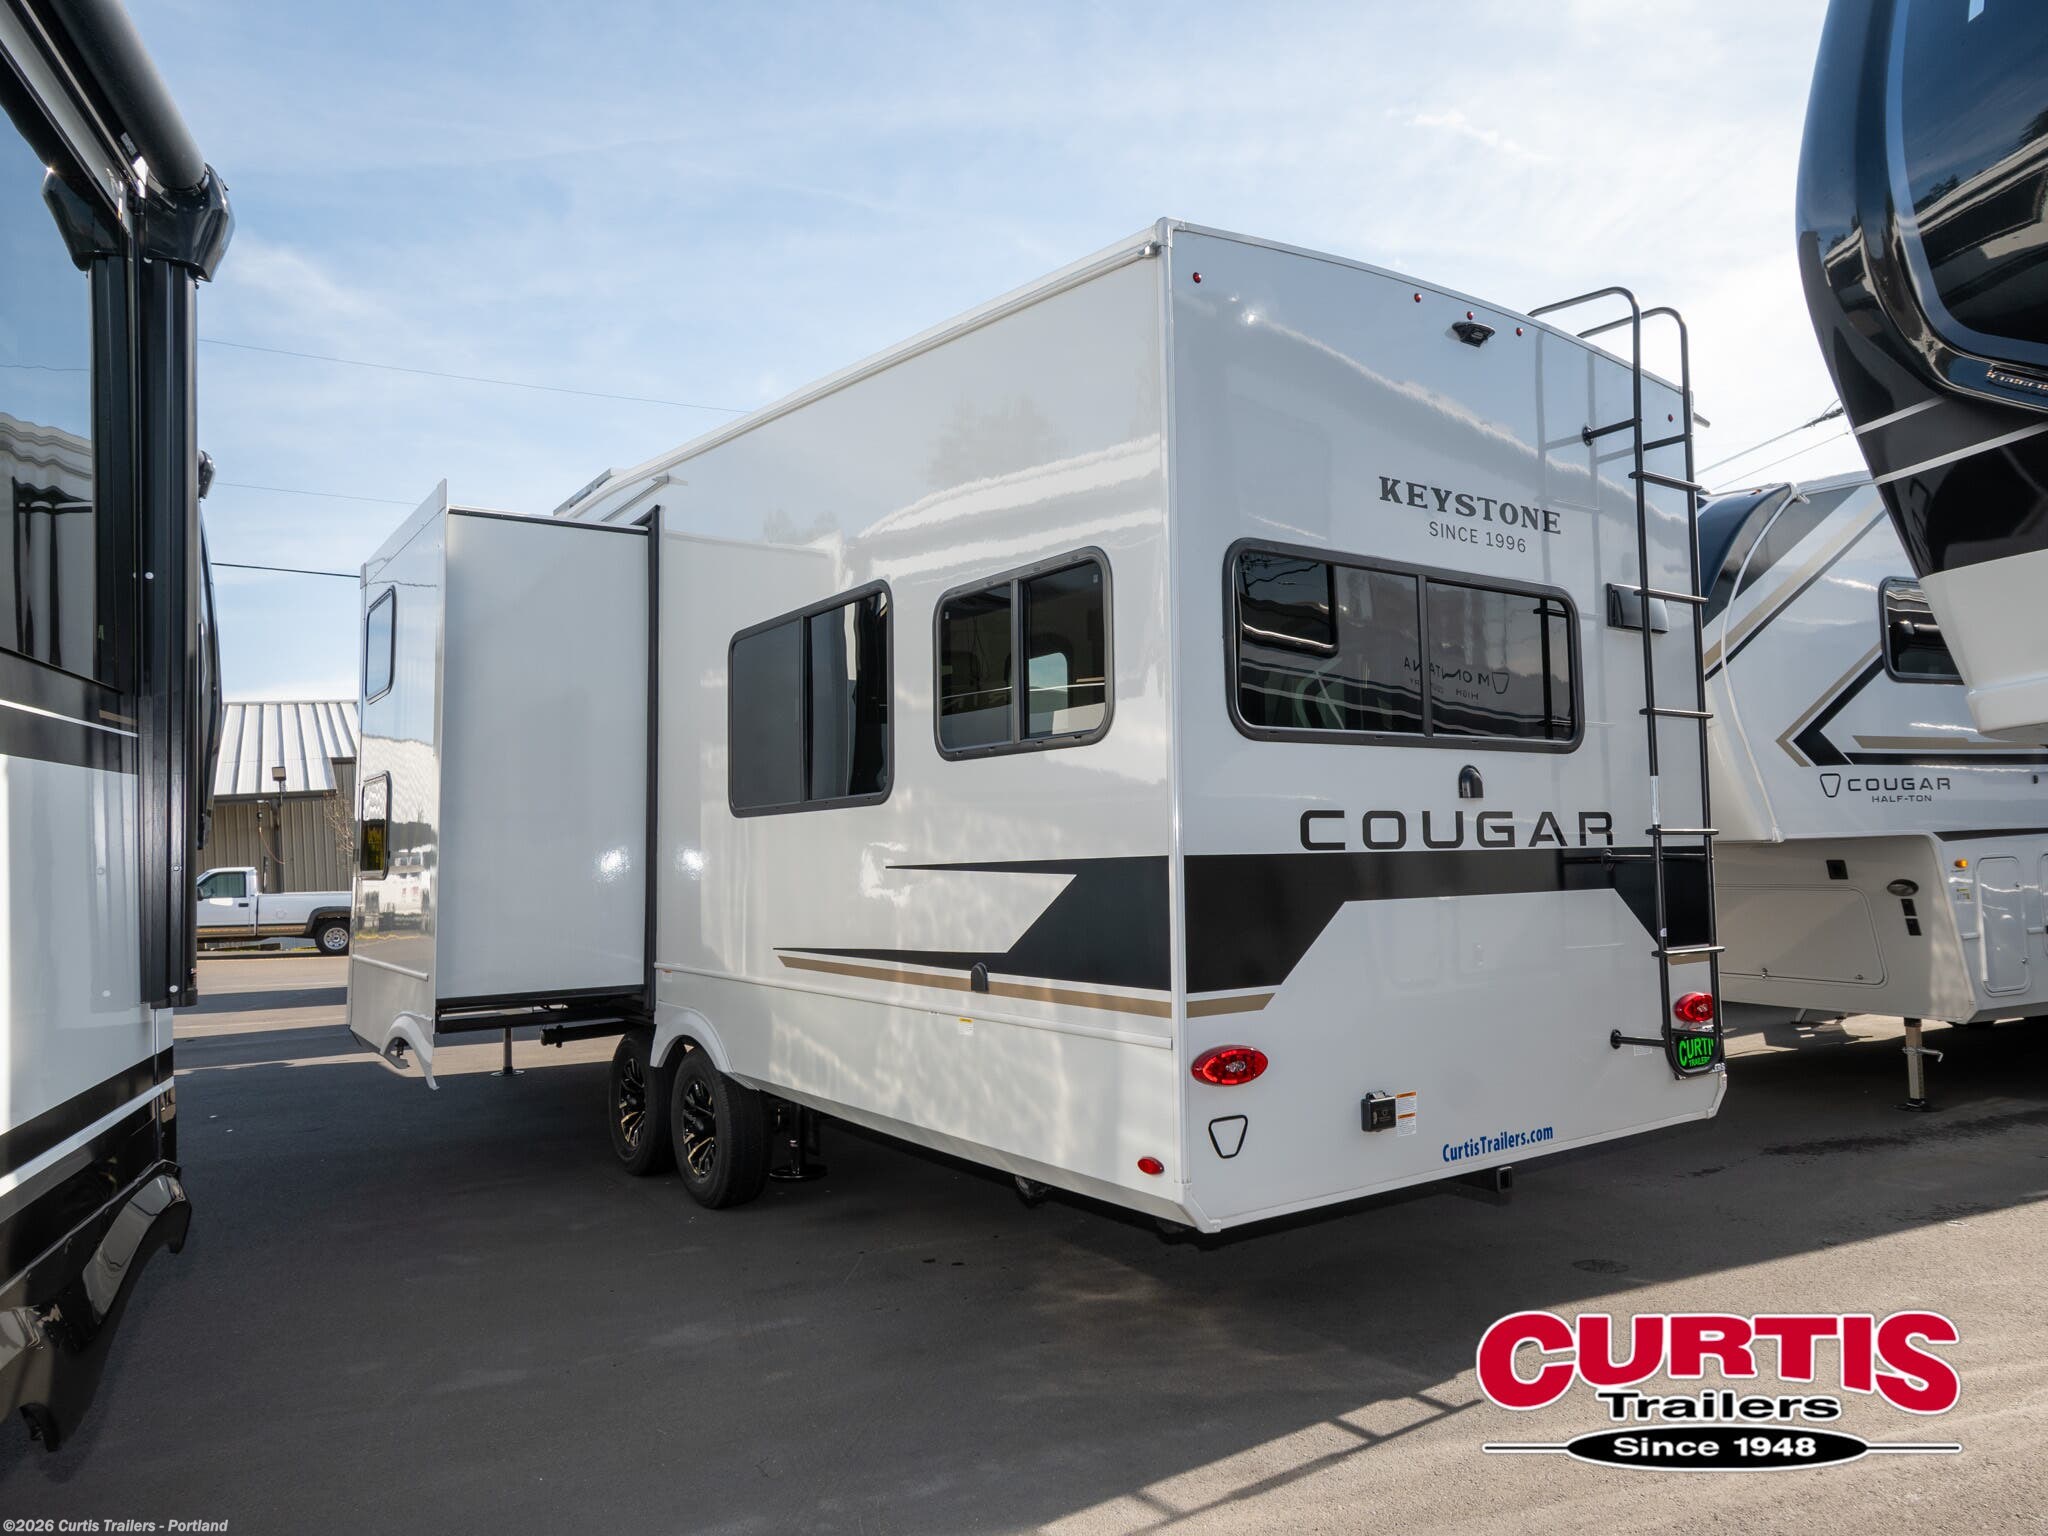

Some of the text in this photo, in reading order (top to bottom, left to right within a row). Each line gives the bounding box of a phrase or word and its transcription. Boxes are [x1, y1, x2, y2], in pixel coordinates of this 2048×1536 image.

[1379, 476, 1561, 535] KEYSTONE
[1429, 521, 1526, 552] SINCE 1996
[1848, 777, 1951, 791] COUGAR
[1872, 794, 1932, 803] HALF-TON
[1300, 810, 1614, 850] COUGAR
[1442, 1126, 1554, 1162] CurtisTrailers.com
